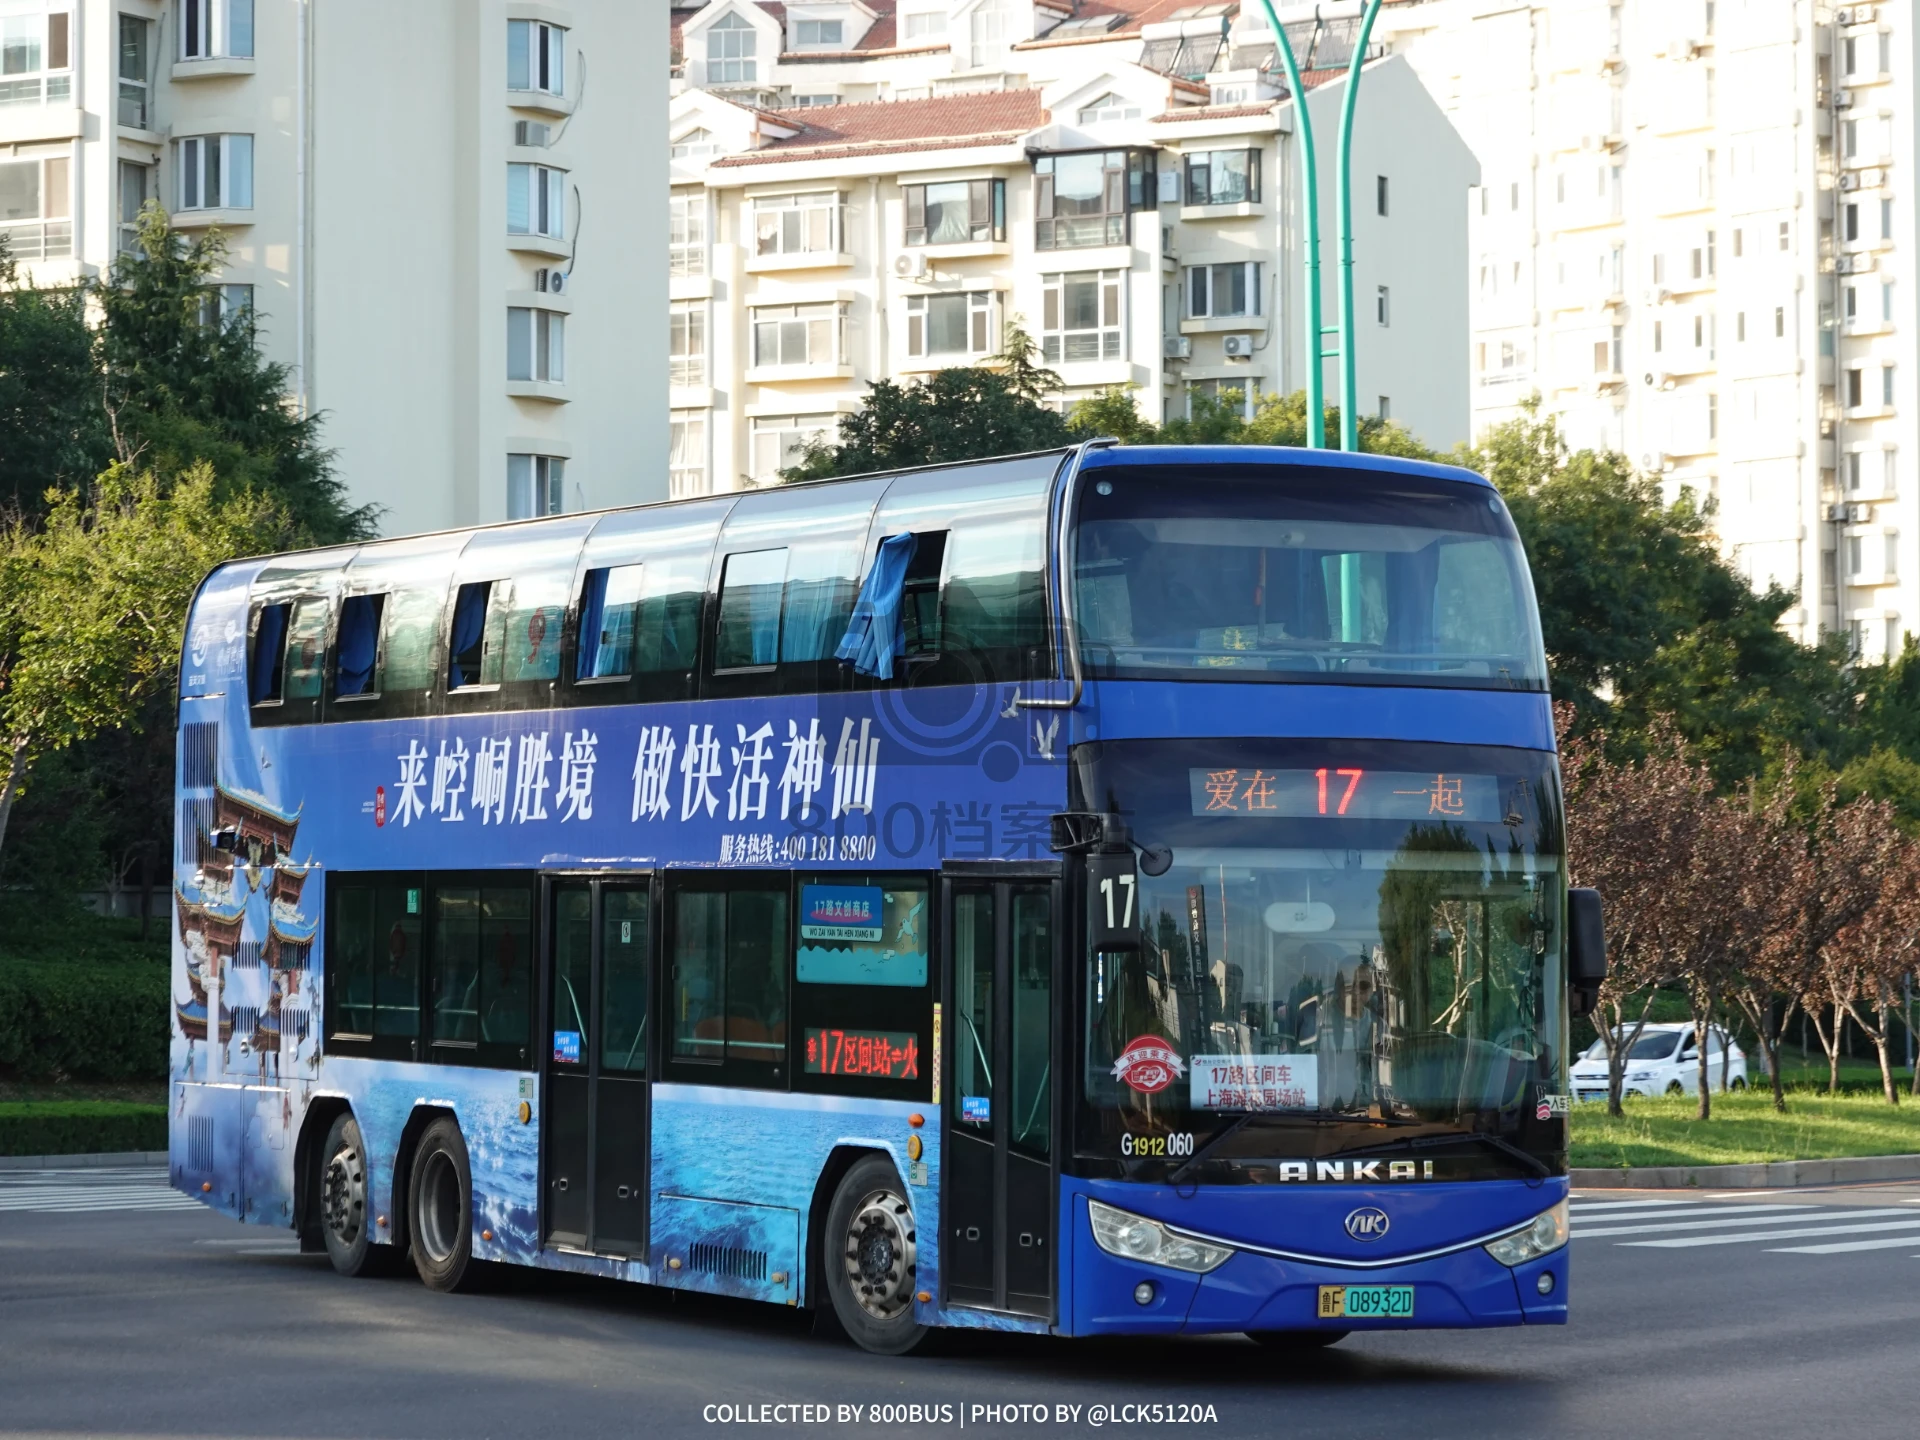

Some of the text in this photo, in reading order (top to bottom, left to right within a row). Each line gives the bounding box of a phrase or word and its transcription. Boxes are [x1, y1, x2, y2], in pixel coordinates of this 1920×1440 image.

[390, 716, 881, 828] 来崆峒胜境 做快活神仙
[1205, 768, 1464, 816] 爱在 17 一起
[814, 899, 870, 918] 17路文创商店
[1101, 874, 1135, 929] 17
[809, 927, 817, 937] WO
[818, 927, 826, 937] ZAI
[827, 928, 836, 937] YAN
[845, 929, 854, 938] HEN
[855, 929, 869, 939] XIANG
[1125, 1049, 1172, 1063] 欢迎乘车
[1211, 1065, 1292, 1085] 17路区间车
[1203, 1088, 1307, 1108] 上海滩花园场站
[1551, 1096, 1569, 1111] 人车
[1279, 1160, 1434, 1182] ANKAI
